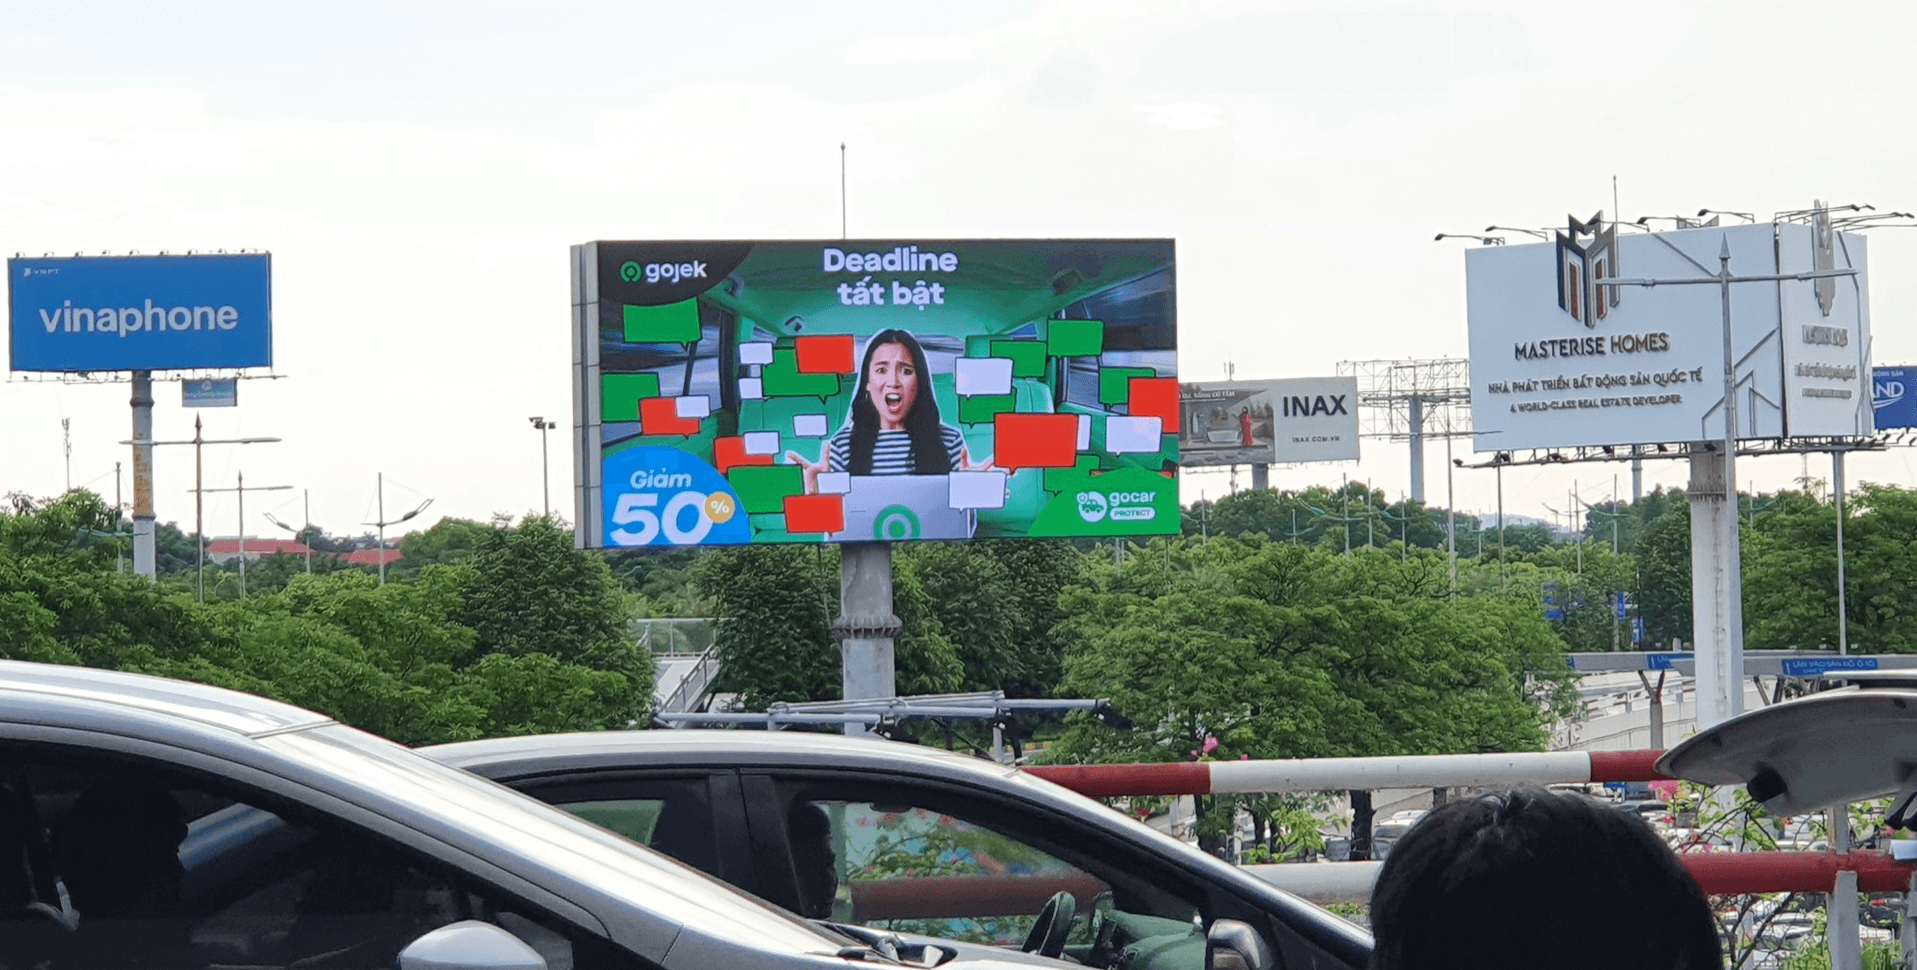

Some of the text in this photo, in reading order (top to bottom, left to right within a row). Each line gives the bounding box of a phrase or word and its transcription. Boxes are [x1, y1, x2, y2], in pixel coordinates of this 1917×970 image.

[646, 260, 708, 282] gojek
[824, 246, 958, 272] Deadline
[838, 276, 945, 310] tất bật
[39, 299, 239, 337] vinaphone
[1514, 332, 1670, 360] MASTERISE HOMES
[1488, 380, 1510, 394] NHÀ
[1512, 379, 1539, 393] PHÁT
[1653, 368, 1687, 388] QUỐC
[1689, 366, 1704, 383] TẾ
[1283, 394, 1348, 417] INAX
[1510, 403, 1517, 413] A
[1518, 399, 1577, 412] WORLD-CLASS
[1578, 399, 1599, 409] REAL
[1601, 397, 1632, 407] ESTATE
[630, 467, 692, 489] Giảm
[1109, 491, 1156, 507] gocar
